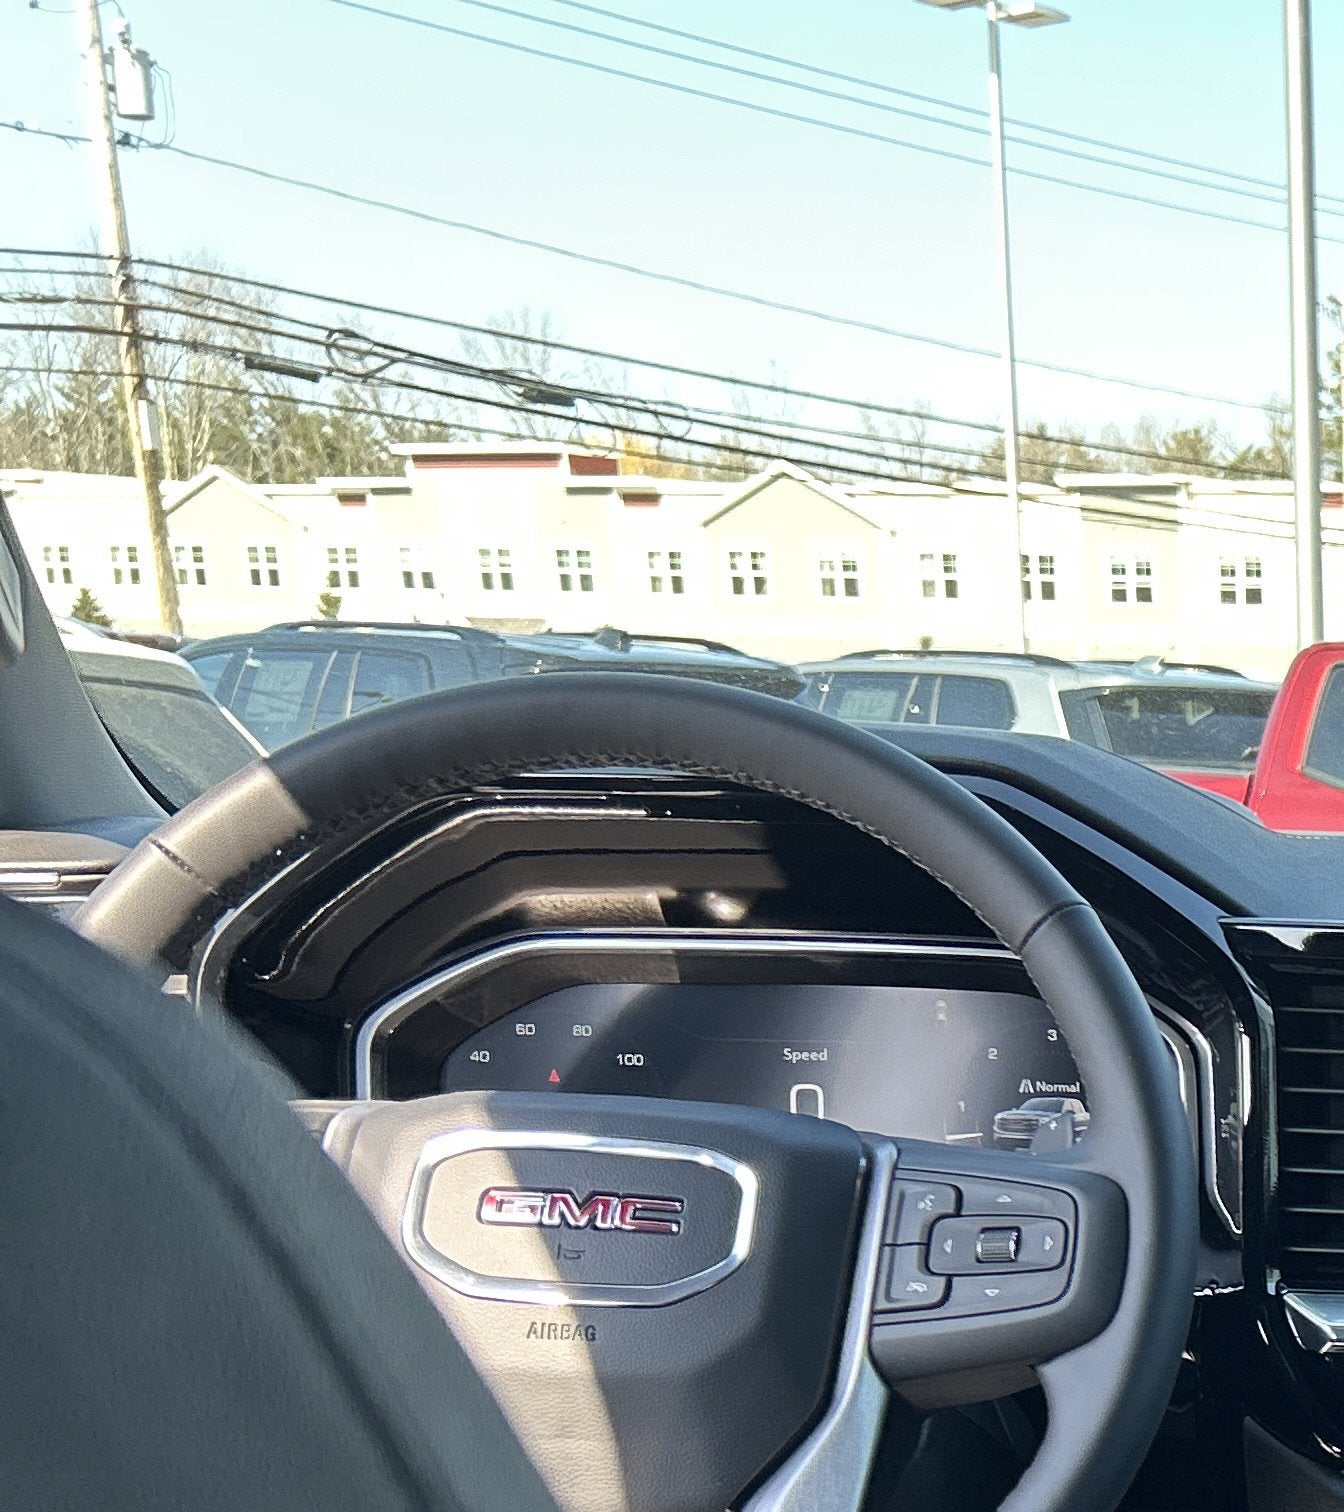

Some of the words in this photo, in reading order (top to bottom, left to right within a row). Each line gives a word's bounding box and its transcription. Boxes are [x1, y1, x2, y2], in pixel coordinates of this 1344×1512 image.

[515, 1023, 536, 1036] 60
[572, 1024, 593, 1037] 80
[1047, 1028, 1058, 1041] 3
[469, 1050, 491, 1063] 40
[615, 1053, 645, 1067] 100
[783, 1047, 828, 1064] Speed
[987, 1047, 998, 1060] 2
[1035, 1080, 1081, 1094] Normal
[958, 1100, 966, 1112] 1
[477, 1186, 687, 1236] GMC
[526, 1320, 597, 1342] AIRBAG
